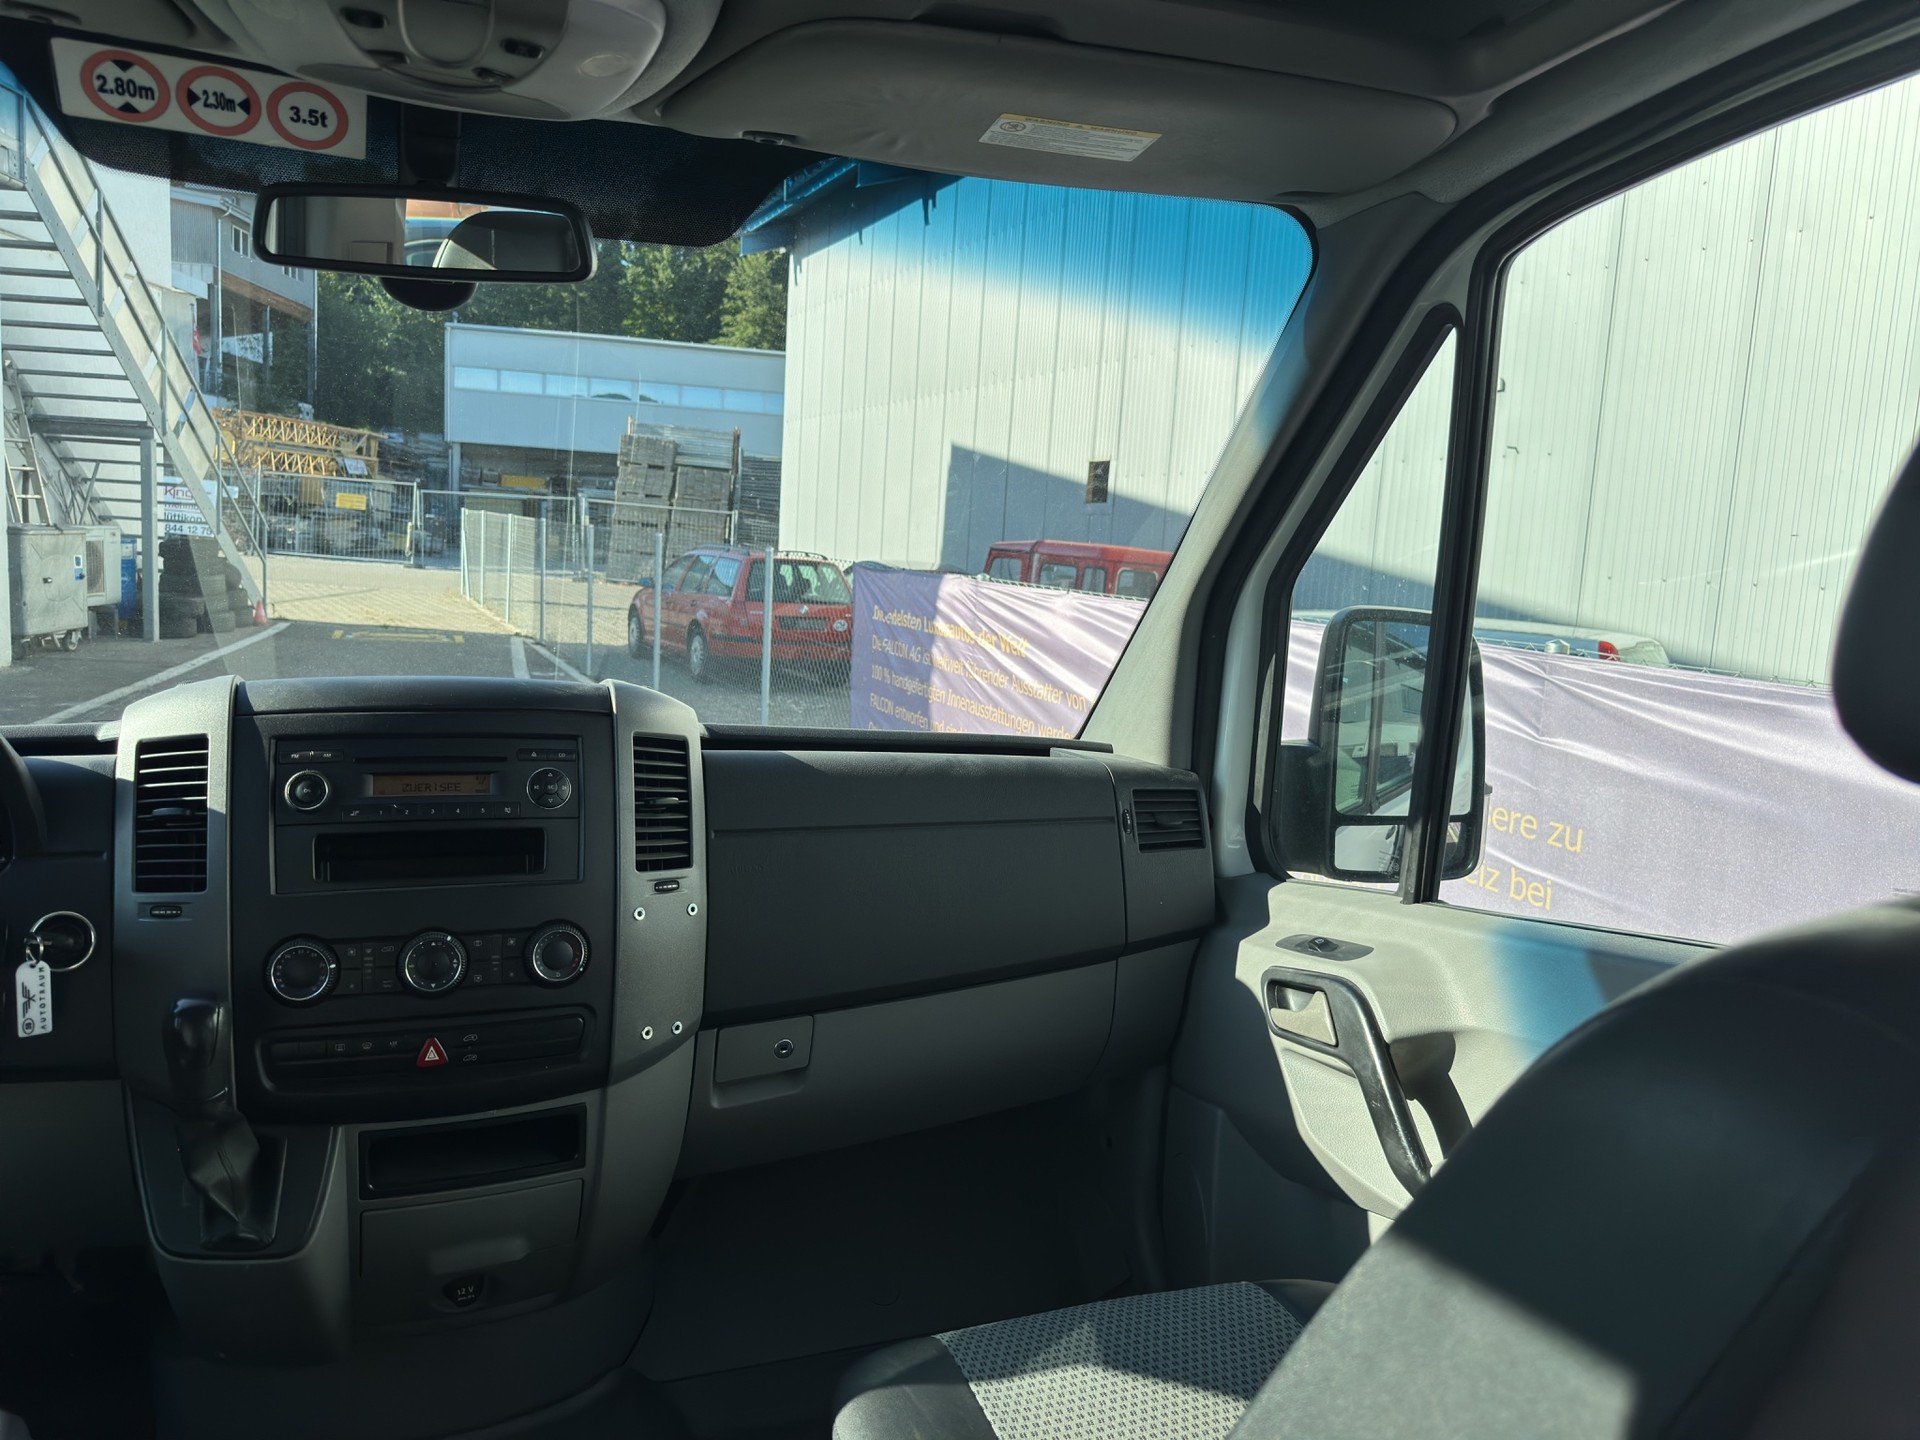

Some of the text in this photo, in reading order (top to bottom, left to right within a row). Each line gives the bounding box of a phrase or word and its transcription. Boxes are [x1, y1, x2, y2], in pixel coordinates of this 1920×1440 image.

[95, 74, 155, 101] 2.80m
[201, 89, 237, 113] 2.30m
[288, 105, 329, 128] 3.5t
[187, 525, 198, 534] 12
[999, 634, 1031, 658] Welt
[882, 638, 909, 658] FALCON
[909, 645, 922, 663] AG
[1011, 674, 1064, 705] Ausstatter
[1066, 691, 1087, 713] von
[869, 692, 894, 715] FALCON
[871, 664, 883, 681] 100
[947, 689, 1035, 734] Innenausstattungen
[1037, 722, 1074, 739] werde
[1547, 821, 1584, 853] zu
[1509, 866, 1552, 910] bei
[38, 966, 48, 1030] AUTOTRAUM
